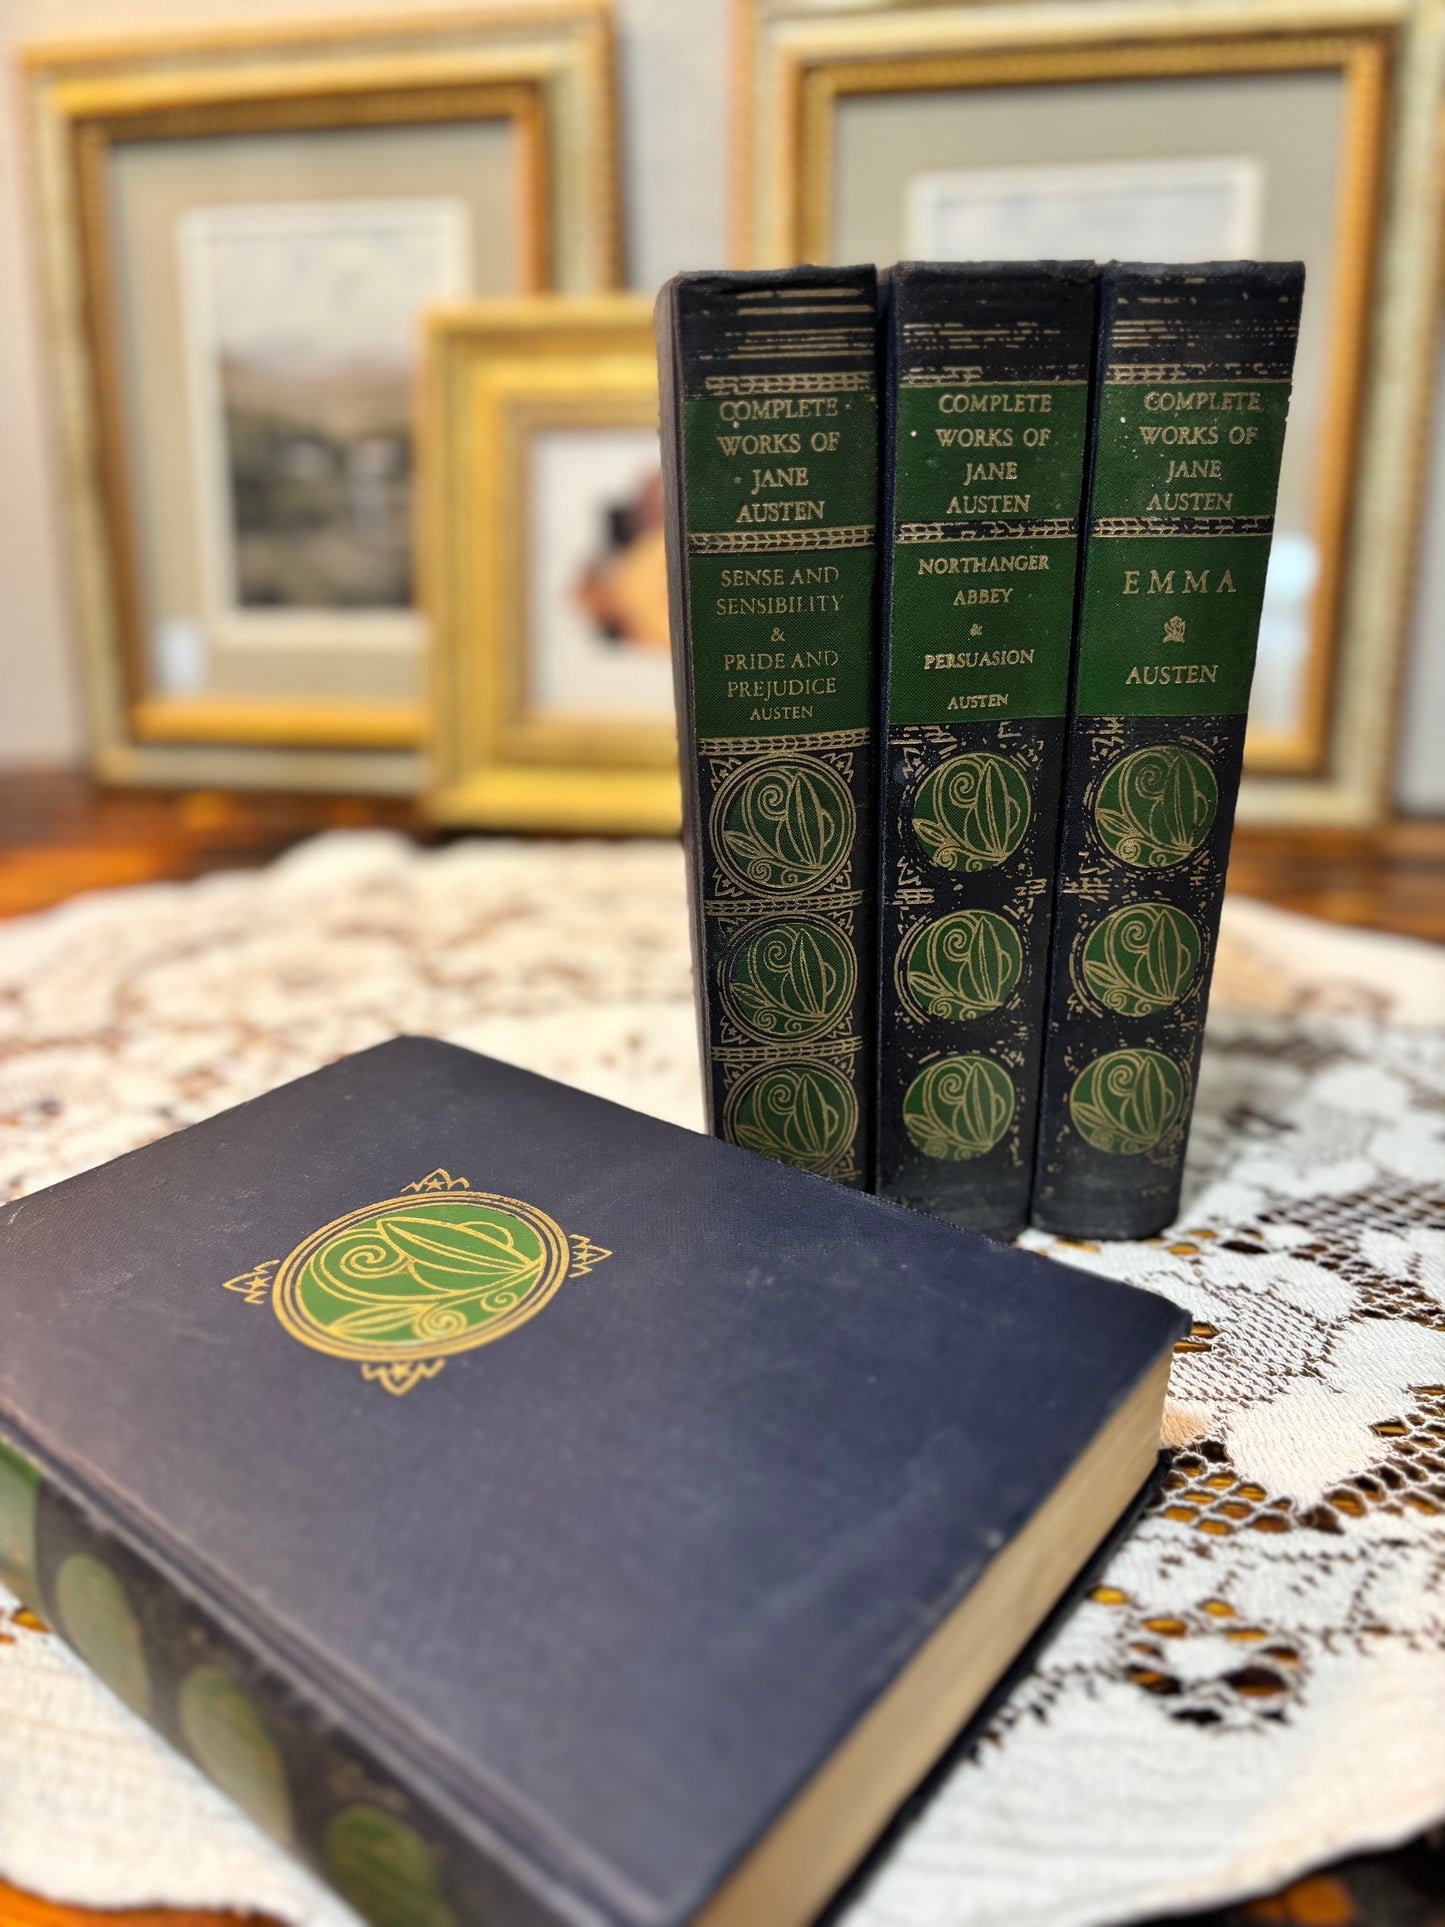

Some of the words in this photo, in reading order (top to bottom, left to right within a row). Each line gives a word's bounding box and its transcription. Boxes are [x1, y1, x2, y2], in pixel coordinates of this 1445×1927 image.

[719, 398, 838, 421] COMPLETE
[938, 393, 1052, 413] COMPLETE
[1143, 391, 1261, 411] COMPLETE
[717, 433, 800, 456] WORKS
[810, 432, 840, 452] OF
[935, 428, 1013, 447] WORKS
[1023, 428, 1051, 447] OF
[1139, 426, 1219, 445] WORKS
[1228, 426, 1258, 445] OF
[751, 467, 809, 495] JANE
[963, 462, 1018, 485] JANE
[1165, 459, 1223, 483] JANE
[946, 494, 1031, 514] AUSTEN
[1146, 492, 1233, 511] AUSTEN
[736, 501, 825, 523] AUSTEN
[917, 554, 1050, 575] NORTHANGER
[721, 569, 785, 587] SENSE
[790, 566, 839, 585] AND
[1122, 569, 1237, 595] EMMA
[716, 595, 844, 615] SENSIBILITY
[953, 587, 1014, 606] ABBEY
[770, 627, 785, 642] &
[969, 623, 983, 637] &
[724, 653, 785, 671] PRIDE
[791, 650, 839, 669] AND
[923, 649, 1035, 670] PERSUASION
[1125, 665, 1219, 685] AUSTEN
[727, 677, 837, 701] PREJUDICE
[947, 693, 1009, 710] AUSTEN
[750, 706, 814, 720] AUSTEN
